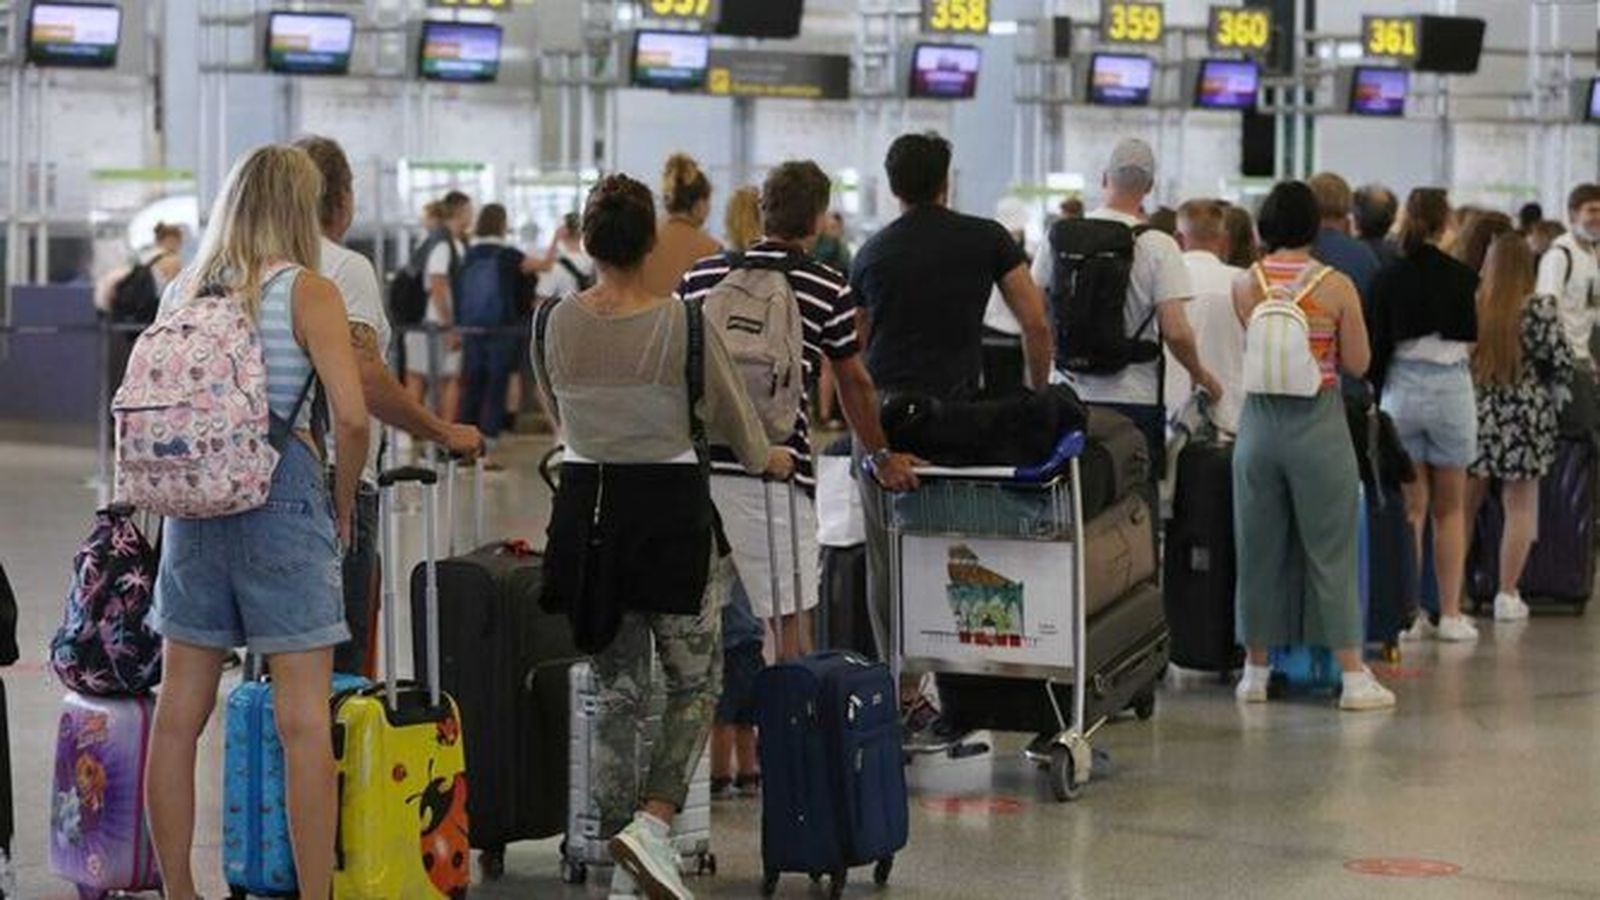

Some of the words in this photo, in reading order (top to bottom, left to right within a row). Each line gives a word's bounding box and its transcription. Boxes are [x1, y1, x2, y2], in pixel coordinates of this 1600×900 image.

[931, 0, 986, 30] 358
[1109, 3, 1161, 41] 359
[1216, 9, 1269, 48] 360
[1369, 18, 1415, 55] 361
